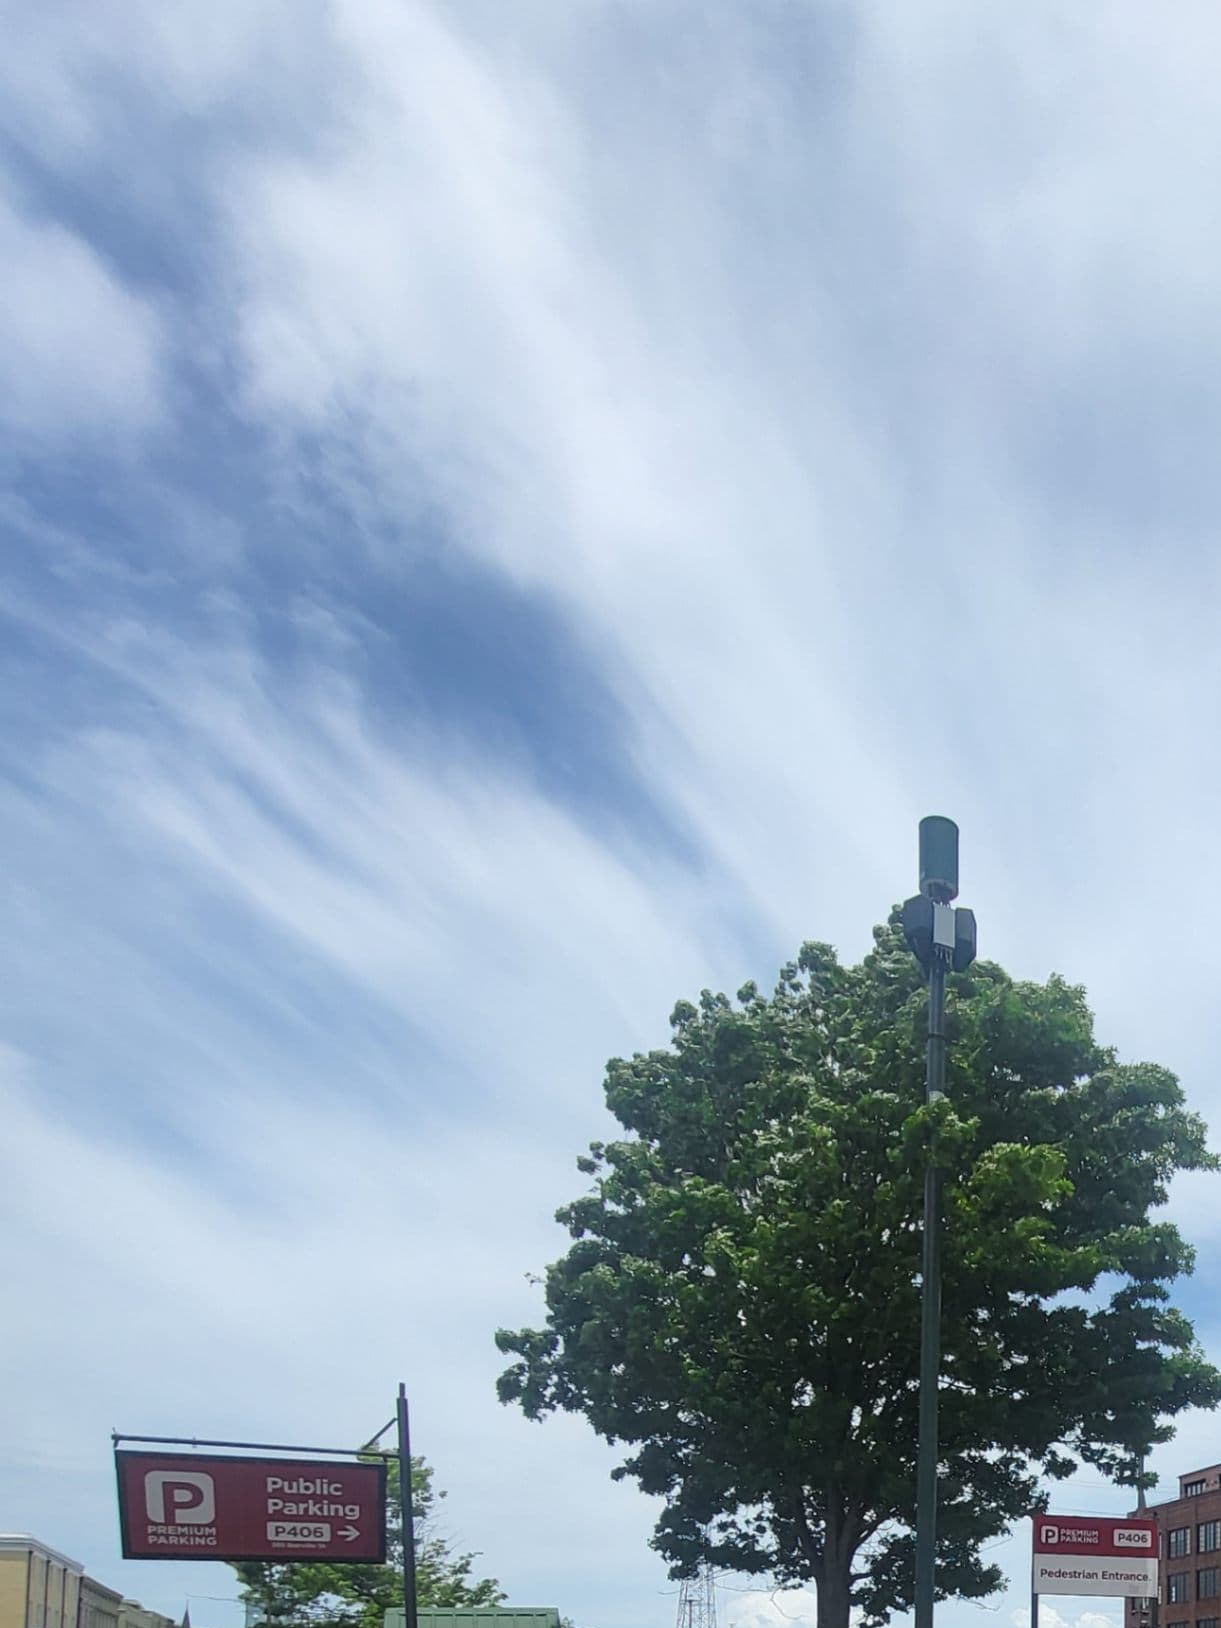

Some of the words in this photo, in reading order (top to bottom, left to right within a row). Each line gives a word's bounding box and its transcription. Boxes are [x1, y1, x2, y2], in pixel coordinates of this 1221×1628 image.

[266, 1477, 343, 1496] Public
[162, 1481, 204, 1524] P
[267, 1498, 361, 1521] Parking
[147, 1525, 217, 1536] PREMIUM
[274, 1525, 324, 1538] P406
[1060, 1528, 1099, 1537] PREMIUM
[148, 1535, 217, 1546] PARKING
[1060, 1536, 1099, 1544] PARKING
[1118, 1533, 1148, 1544] P406
[1040, 1568, 1098, 1580] Pedestrian
